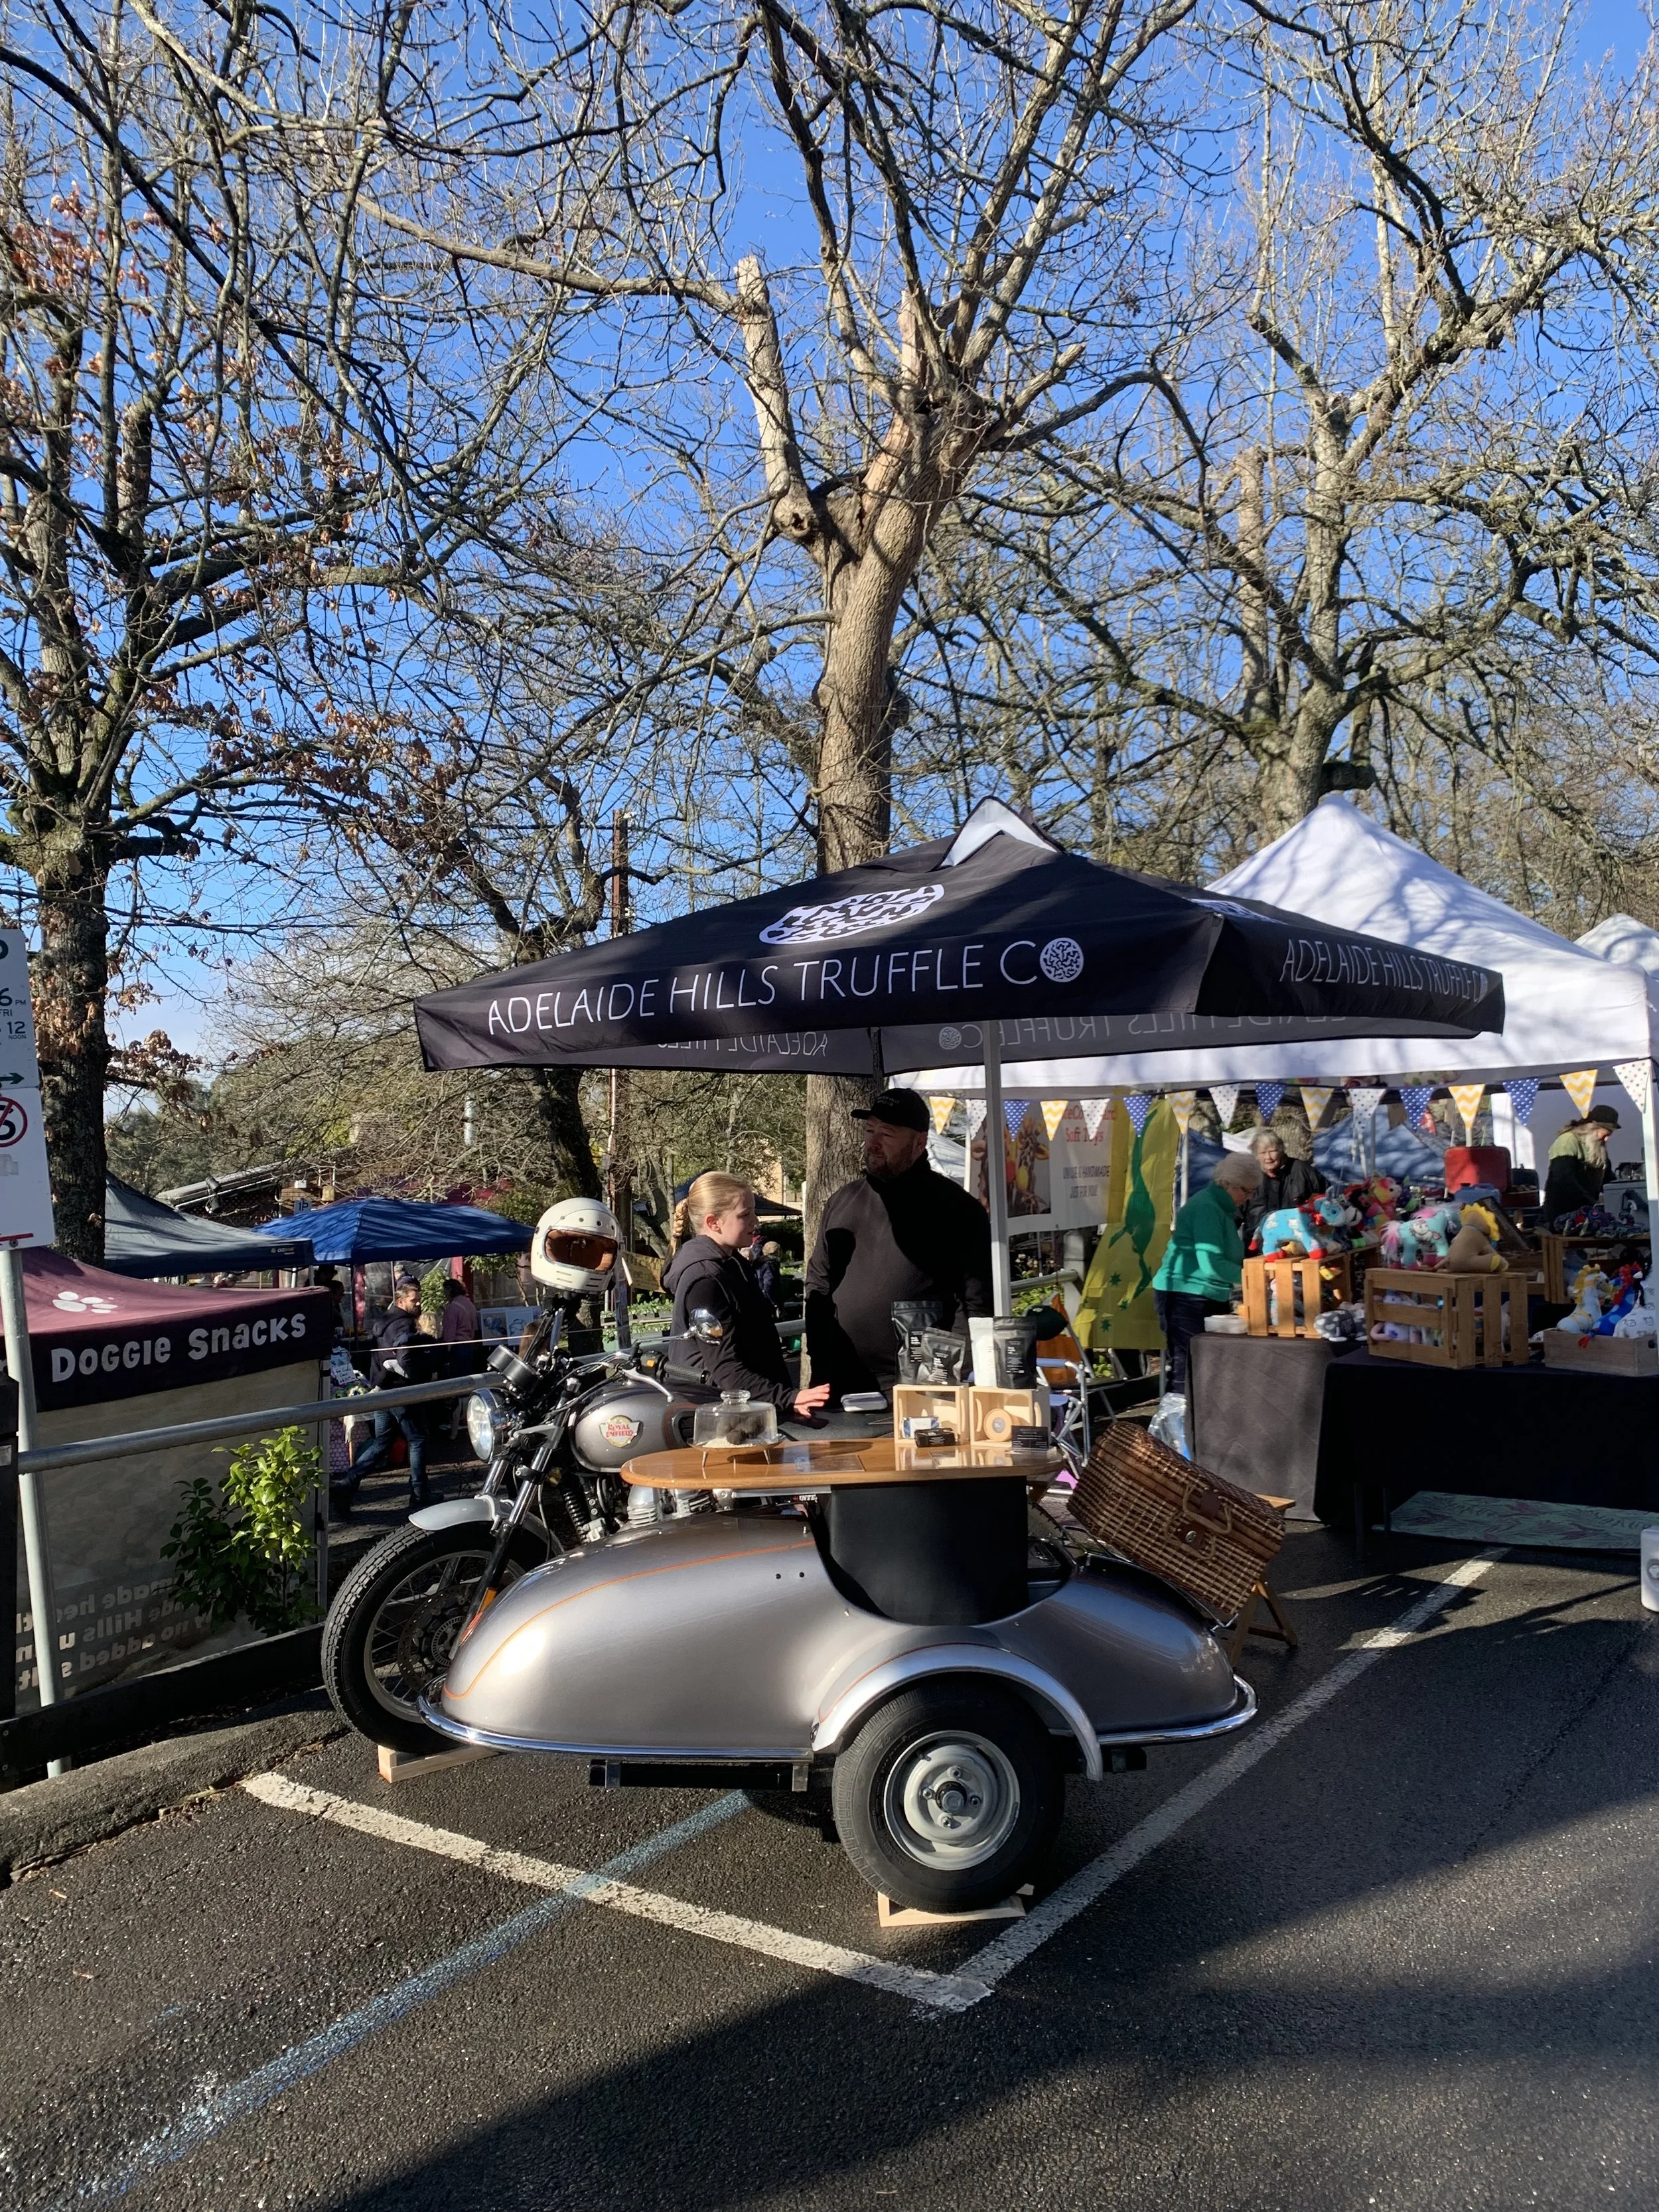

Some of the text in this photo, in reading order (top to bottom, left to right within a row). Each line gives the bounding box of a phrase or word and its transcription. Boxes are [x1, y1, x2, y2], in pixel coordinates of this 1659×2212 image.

[1279, 938, 1380, 986] ADELAIDE
[1376, 948, 1425, 991] HILLS
[1419, 956, 1472, 1000] TRUFFLE
[488, 979, 660, 1035] ADELAIDE
[669, 965, 779, 1013] HILLS
[793, 944, 984, 1001] TRUFFLE
[7, 1021, 26, 1035] 12
[1066, 1127, 1104, 1146] Soft Tys
[606, 1430, 634, 1438] ENFIELD
